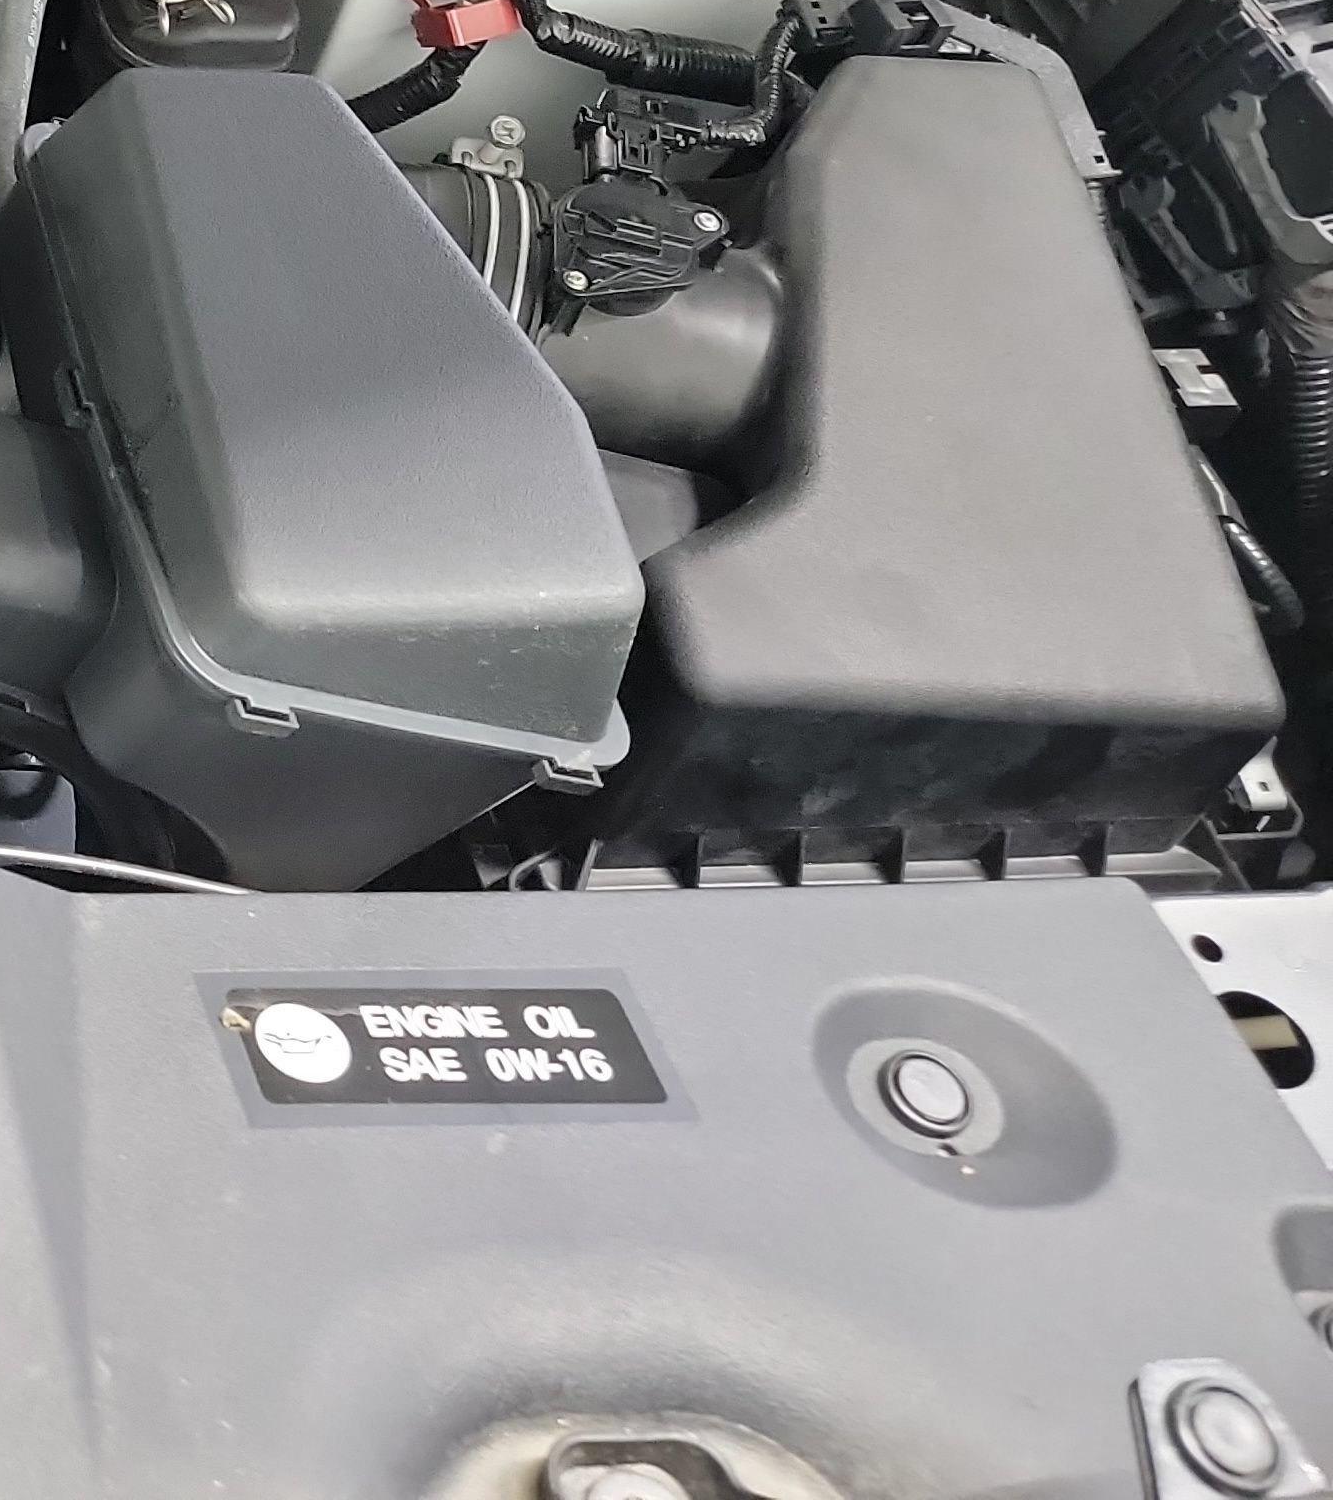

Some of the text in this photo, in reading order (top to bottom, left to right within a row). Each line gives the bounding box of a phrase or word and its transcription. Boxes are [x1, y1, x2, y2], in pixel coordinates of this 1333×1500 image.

[359, 1004, 596, 1039] ENGINE OIL
[378, 1047, 615, 1083] SAE 0W-16
